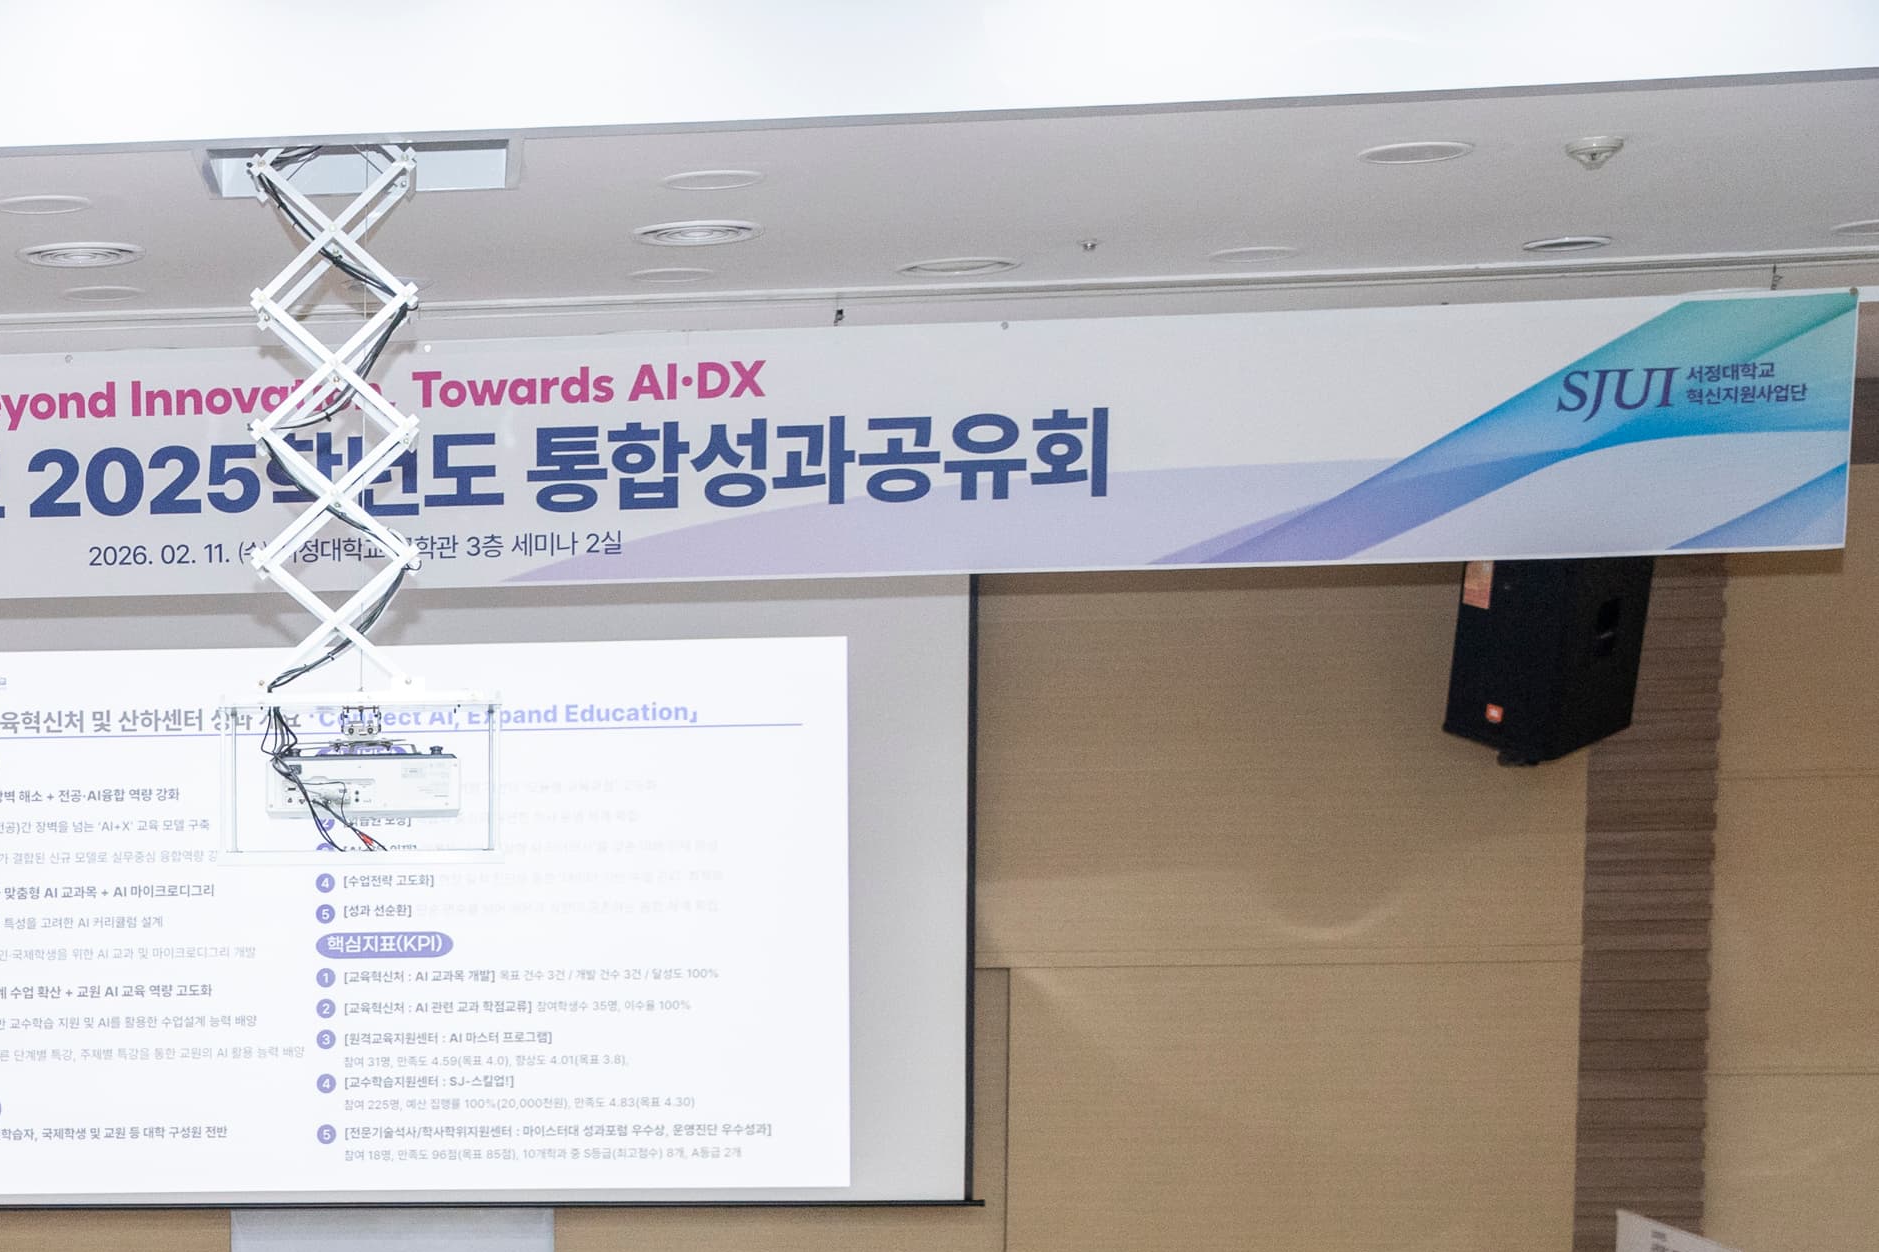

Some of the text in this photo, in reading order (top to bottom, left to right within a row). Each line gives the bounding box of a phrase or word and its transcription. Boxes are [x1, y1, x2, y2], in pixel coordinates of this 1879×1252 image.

[1686, 362, 1776, 382] 서정대학교
[412, 366, 614, 408] Towards
[628, 359, 766, 402] AI·DX
[1557, 367, 1681, 422] SJUI
[1685, 384, 1808, 405] 혁신지원사업단
[526, 407, 1109, 513] 통합성과공유회
[89, 545, 153, 567] 2026.
[161, 543, 196, 565] 02.
[204, 542, 230, 564] 11.
[466, 534, 504, 559] 3층
[511, 531, 578, 557] 세미나
[585, 530, 623, 557] 2실
[91, 709, 110, 732] 및
[118, 708, 203, 731] 산하센터
[19, 790, 42, 803] 해소
[58, 788, 124, 802] 전공·AI융합
[129, 788, 152, 801] 역량
[156, 787, 179, 801] 강화
[35, 820, 68, 833] 장벽을
[72, 820, 93, 832] 넘는
[137, 819, 158, 831] 교육
[163, 819, 184, 831] 모델
[188, 819, 209, 830] 구축
[343, 874, 392, 888] [수업전략
[396, 874, 434, 887] 고도화]
[4, 886, 39, 900] 맞춤형
[44, 887, 57, 898] AI
[61, 885, 97, 899] 교과목
[113, 886, 127, 897] AI
[130, 883, 214, 898] 마이크로디그리
[343, 904, 370, 918] [성과
[374, 904, 411, 918] 선순환]
[4, 916, 36, 929] 특성을
[41, 916, 73, 929] 고려한
[77, 917, 89, 927] AI
[93, 916, 137, 928] 커리큘럼
[141, 915, 162, 928] 설계
[327, 934, 442, 953] 핵심지표(KPI)
[10, 986, 33, 999] 수업
[37, 985, 61, 999] 확산
[77, 985, 100, 998] 교원
[104, 986, 118, 997] AI
[121, 984, 145, 997] 교육
[149, 984, 172, 997] 역량
[176, 984, 211, 997] 고도화
[9, 1017, 53, 1030] 교수학습
[58, 1016, 79, 1029] 지원
[83, 1017, 93, 1028] 및
[97, 1016, 120, 1028] AI를
[125, 1015, 157, 1028] 활용한
[161, 1015, 205, 1028] 수업설계
[209, 1015, 231, 1027] 능력
[235, 1015, 256, 1027] 배양
[42, 1127, 86, 1140] 국제학생
[89, 1127, 100, 1139] 및
[103, 1126, 125, 1139] 교원
[129, 1126, 139, 1139] 등
[143, 1126, 165, 1139] 대학
[169, 1126, 201, 1138] 구성원
[205, 1125, 227, 1138] 전반
